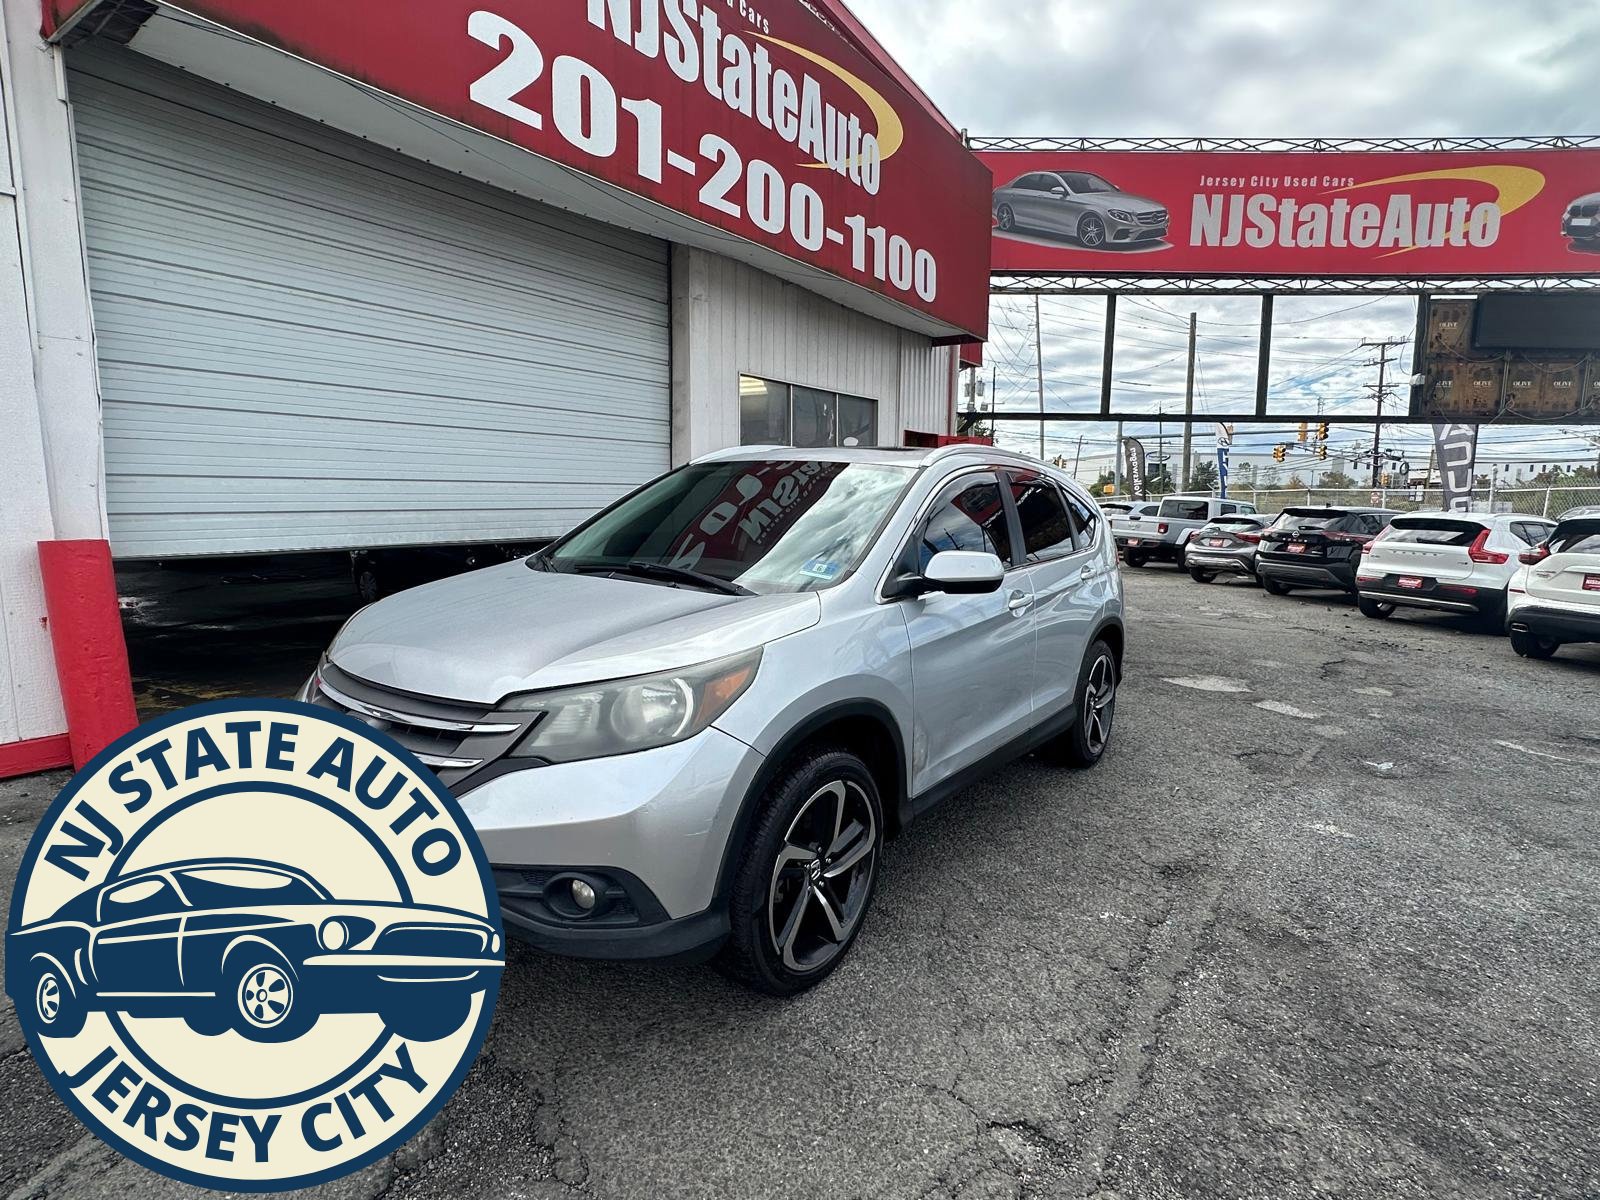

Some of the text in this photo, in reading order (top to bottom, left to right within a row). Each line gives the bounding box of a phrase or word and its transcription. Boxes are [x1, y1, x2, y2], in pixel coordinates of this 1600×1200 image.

[740, 4, 769, 34] Cars
[468, 11, 937, 303] 201-200-1100
[1200, 175, 1355, 188] Jersey City Used Cars
[1189, 193, 1501, 248] NJStateAuto
